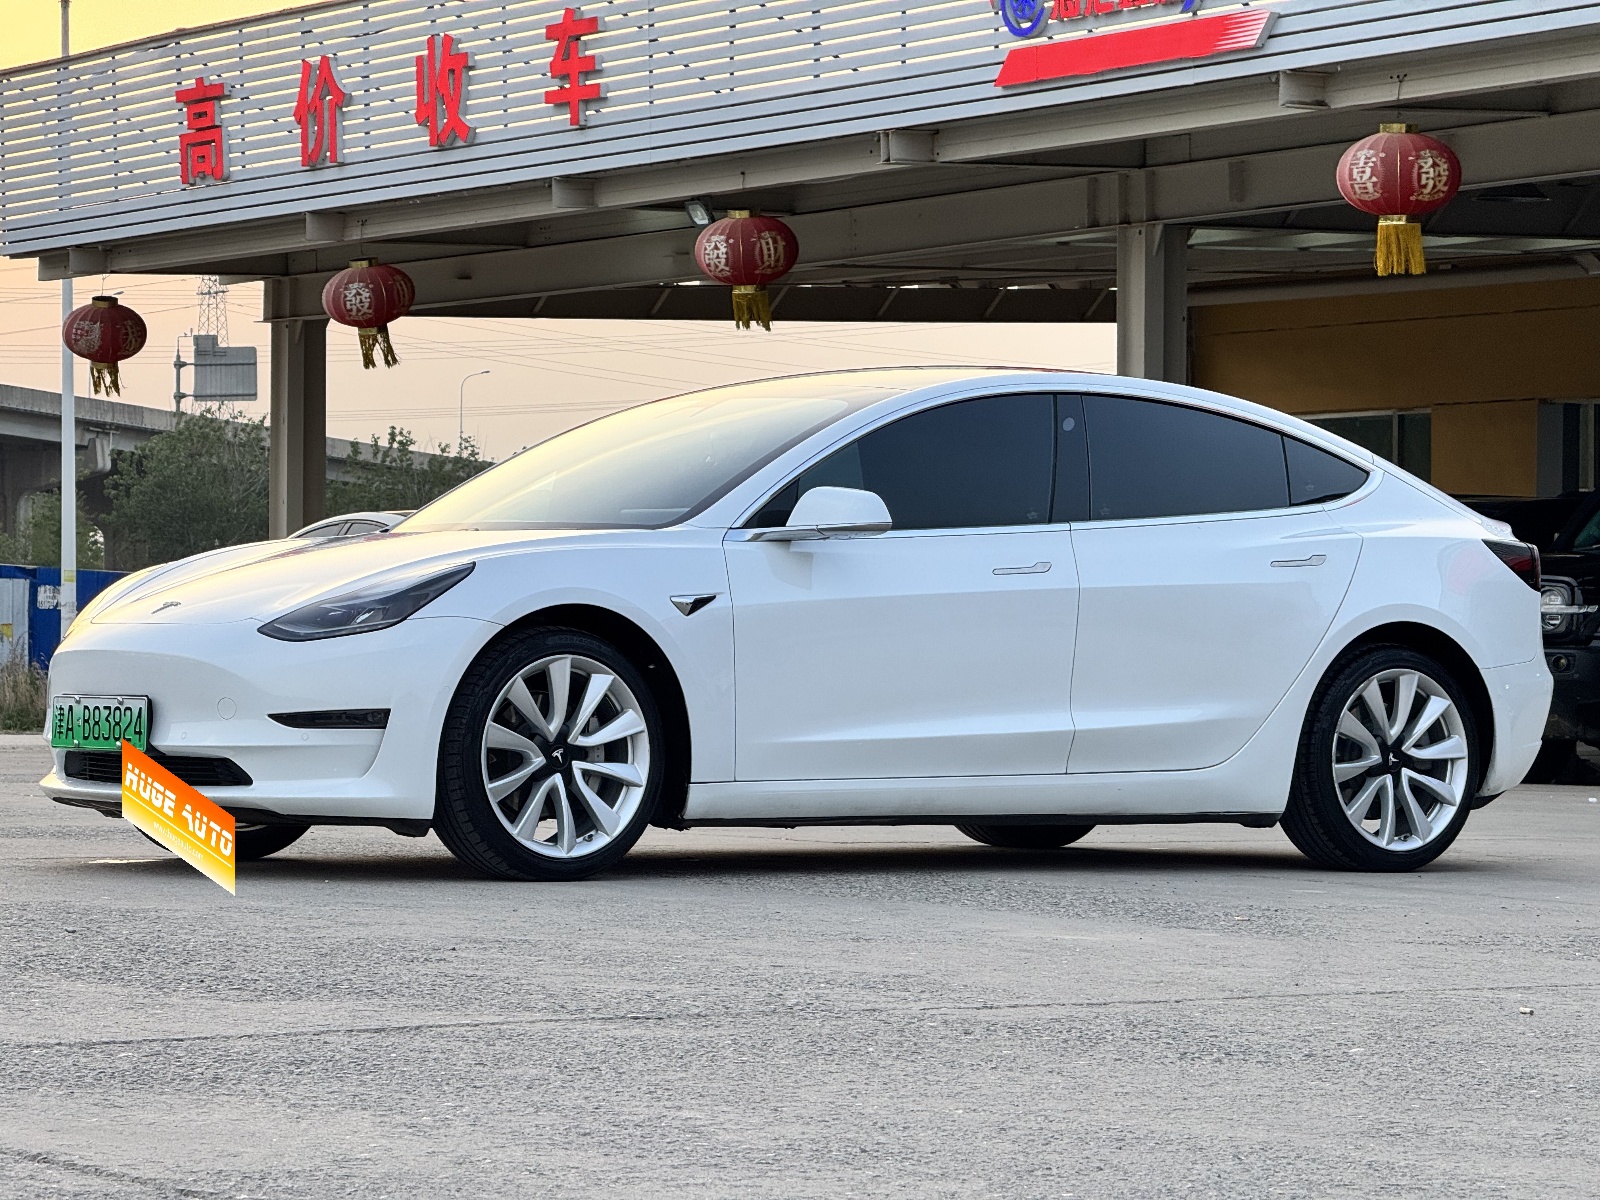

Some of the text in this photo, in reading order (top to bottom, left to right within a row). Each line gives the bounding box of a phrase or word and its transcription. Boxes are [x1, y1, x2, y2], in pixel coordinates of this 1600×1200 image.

[175, 8, 608, 185] 高价收车
[1350, 153, 1378, 194] 喜
